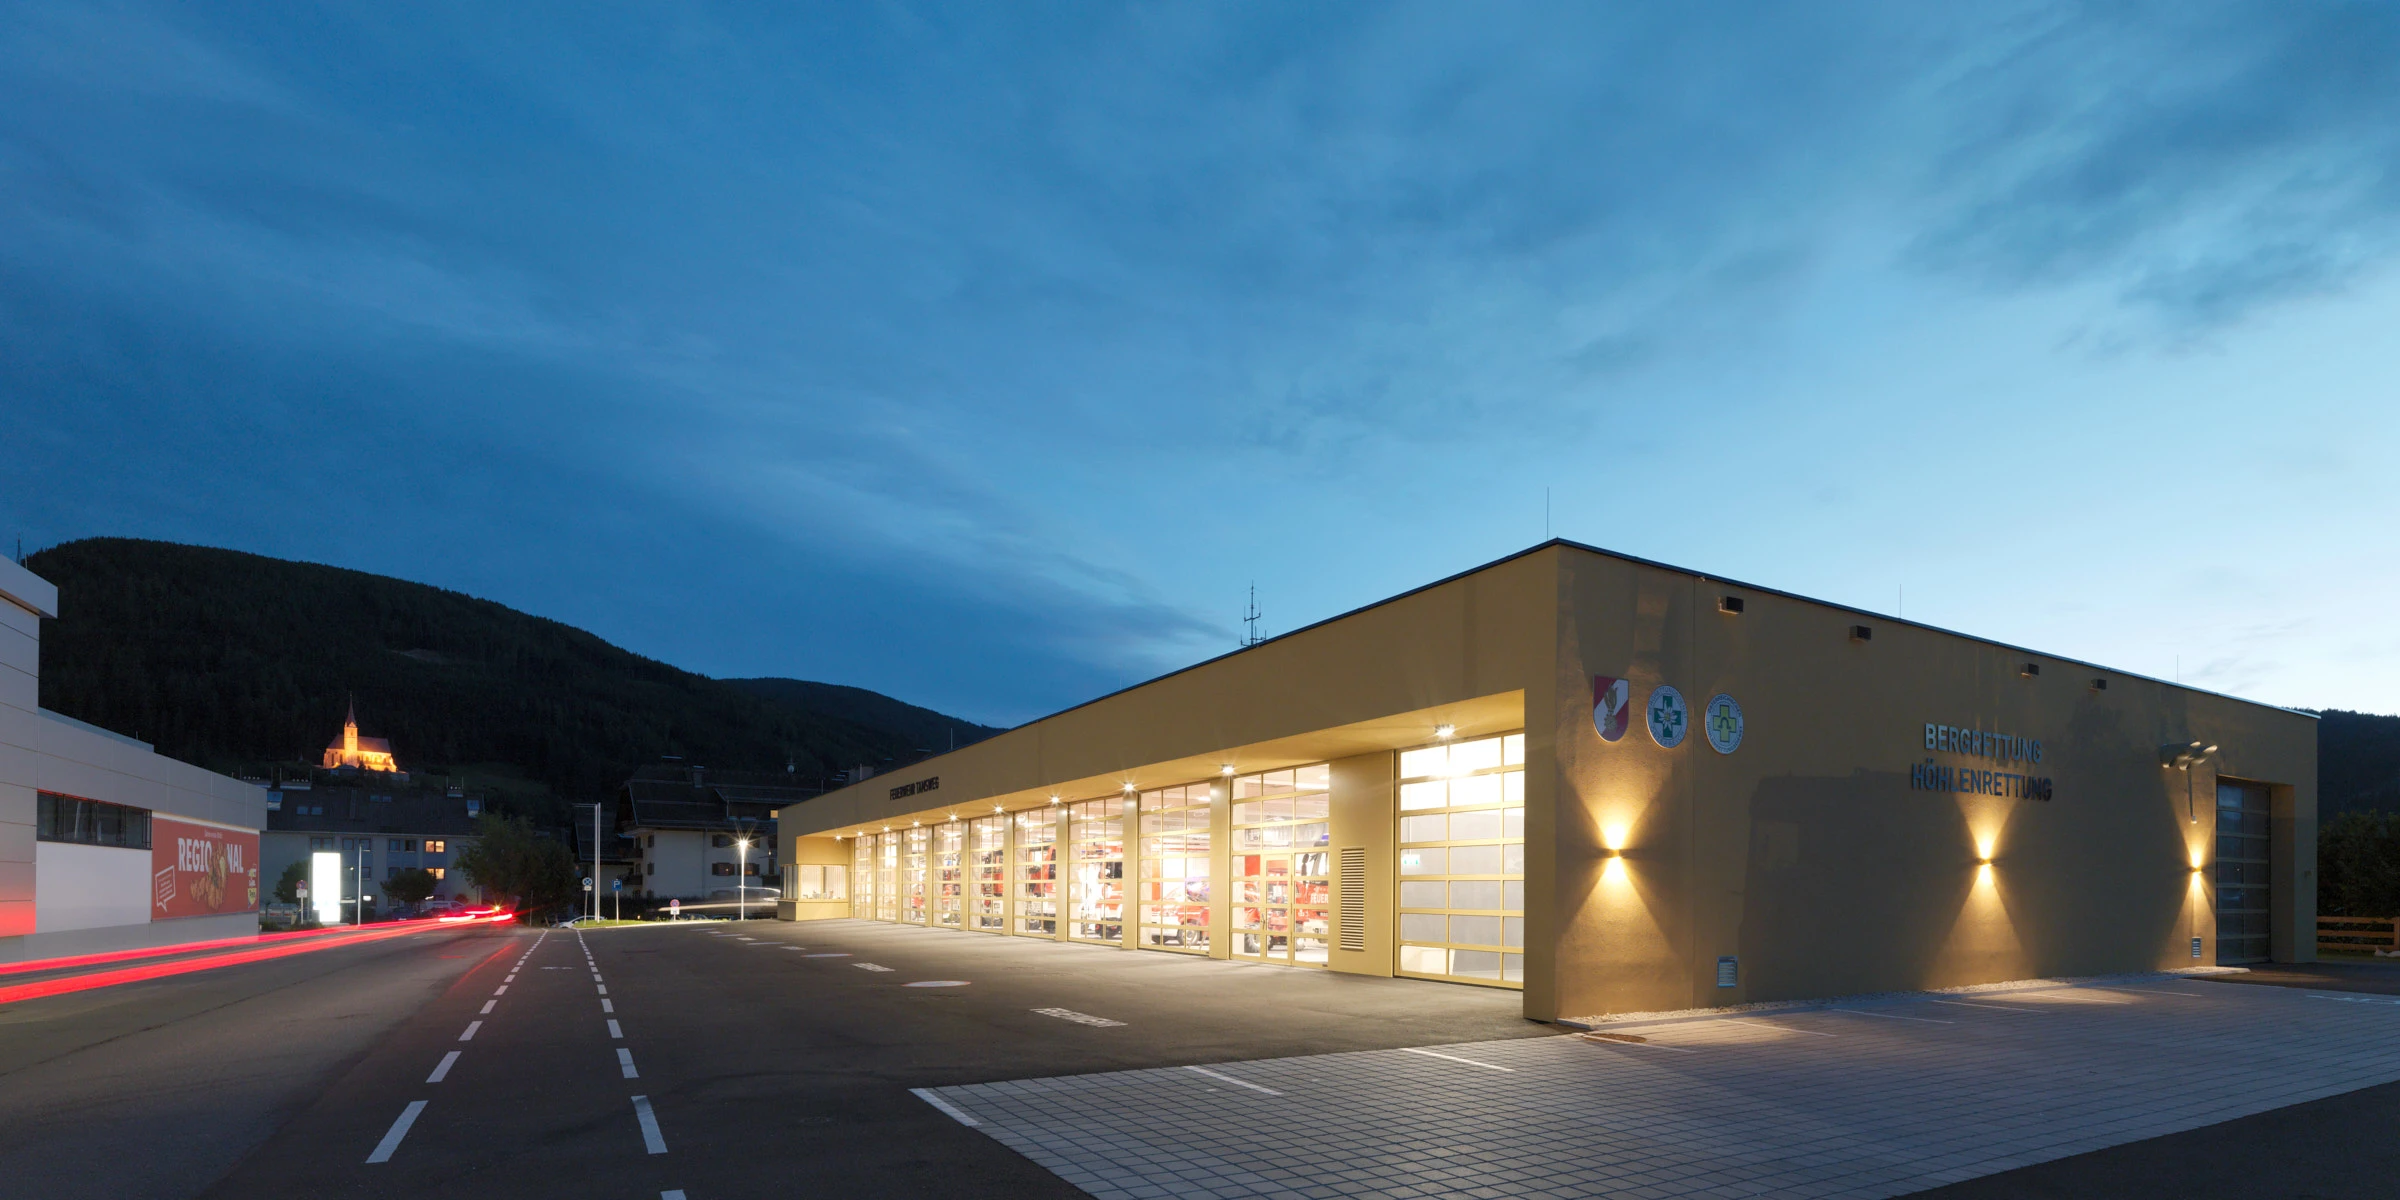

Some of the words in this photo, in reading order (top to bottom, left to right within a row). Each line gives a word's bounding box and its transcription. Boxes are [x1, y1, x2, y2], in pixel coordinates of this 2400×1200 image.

[1924, 723, 2043, 764] BERGRETTUNG
[890, 783, 915, 800] FEUERWEHR
[916, 776, 939, 795] TAMSWEG
[1911, 757, 2053, 802] HÖHLENRETTUNG
